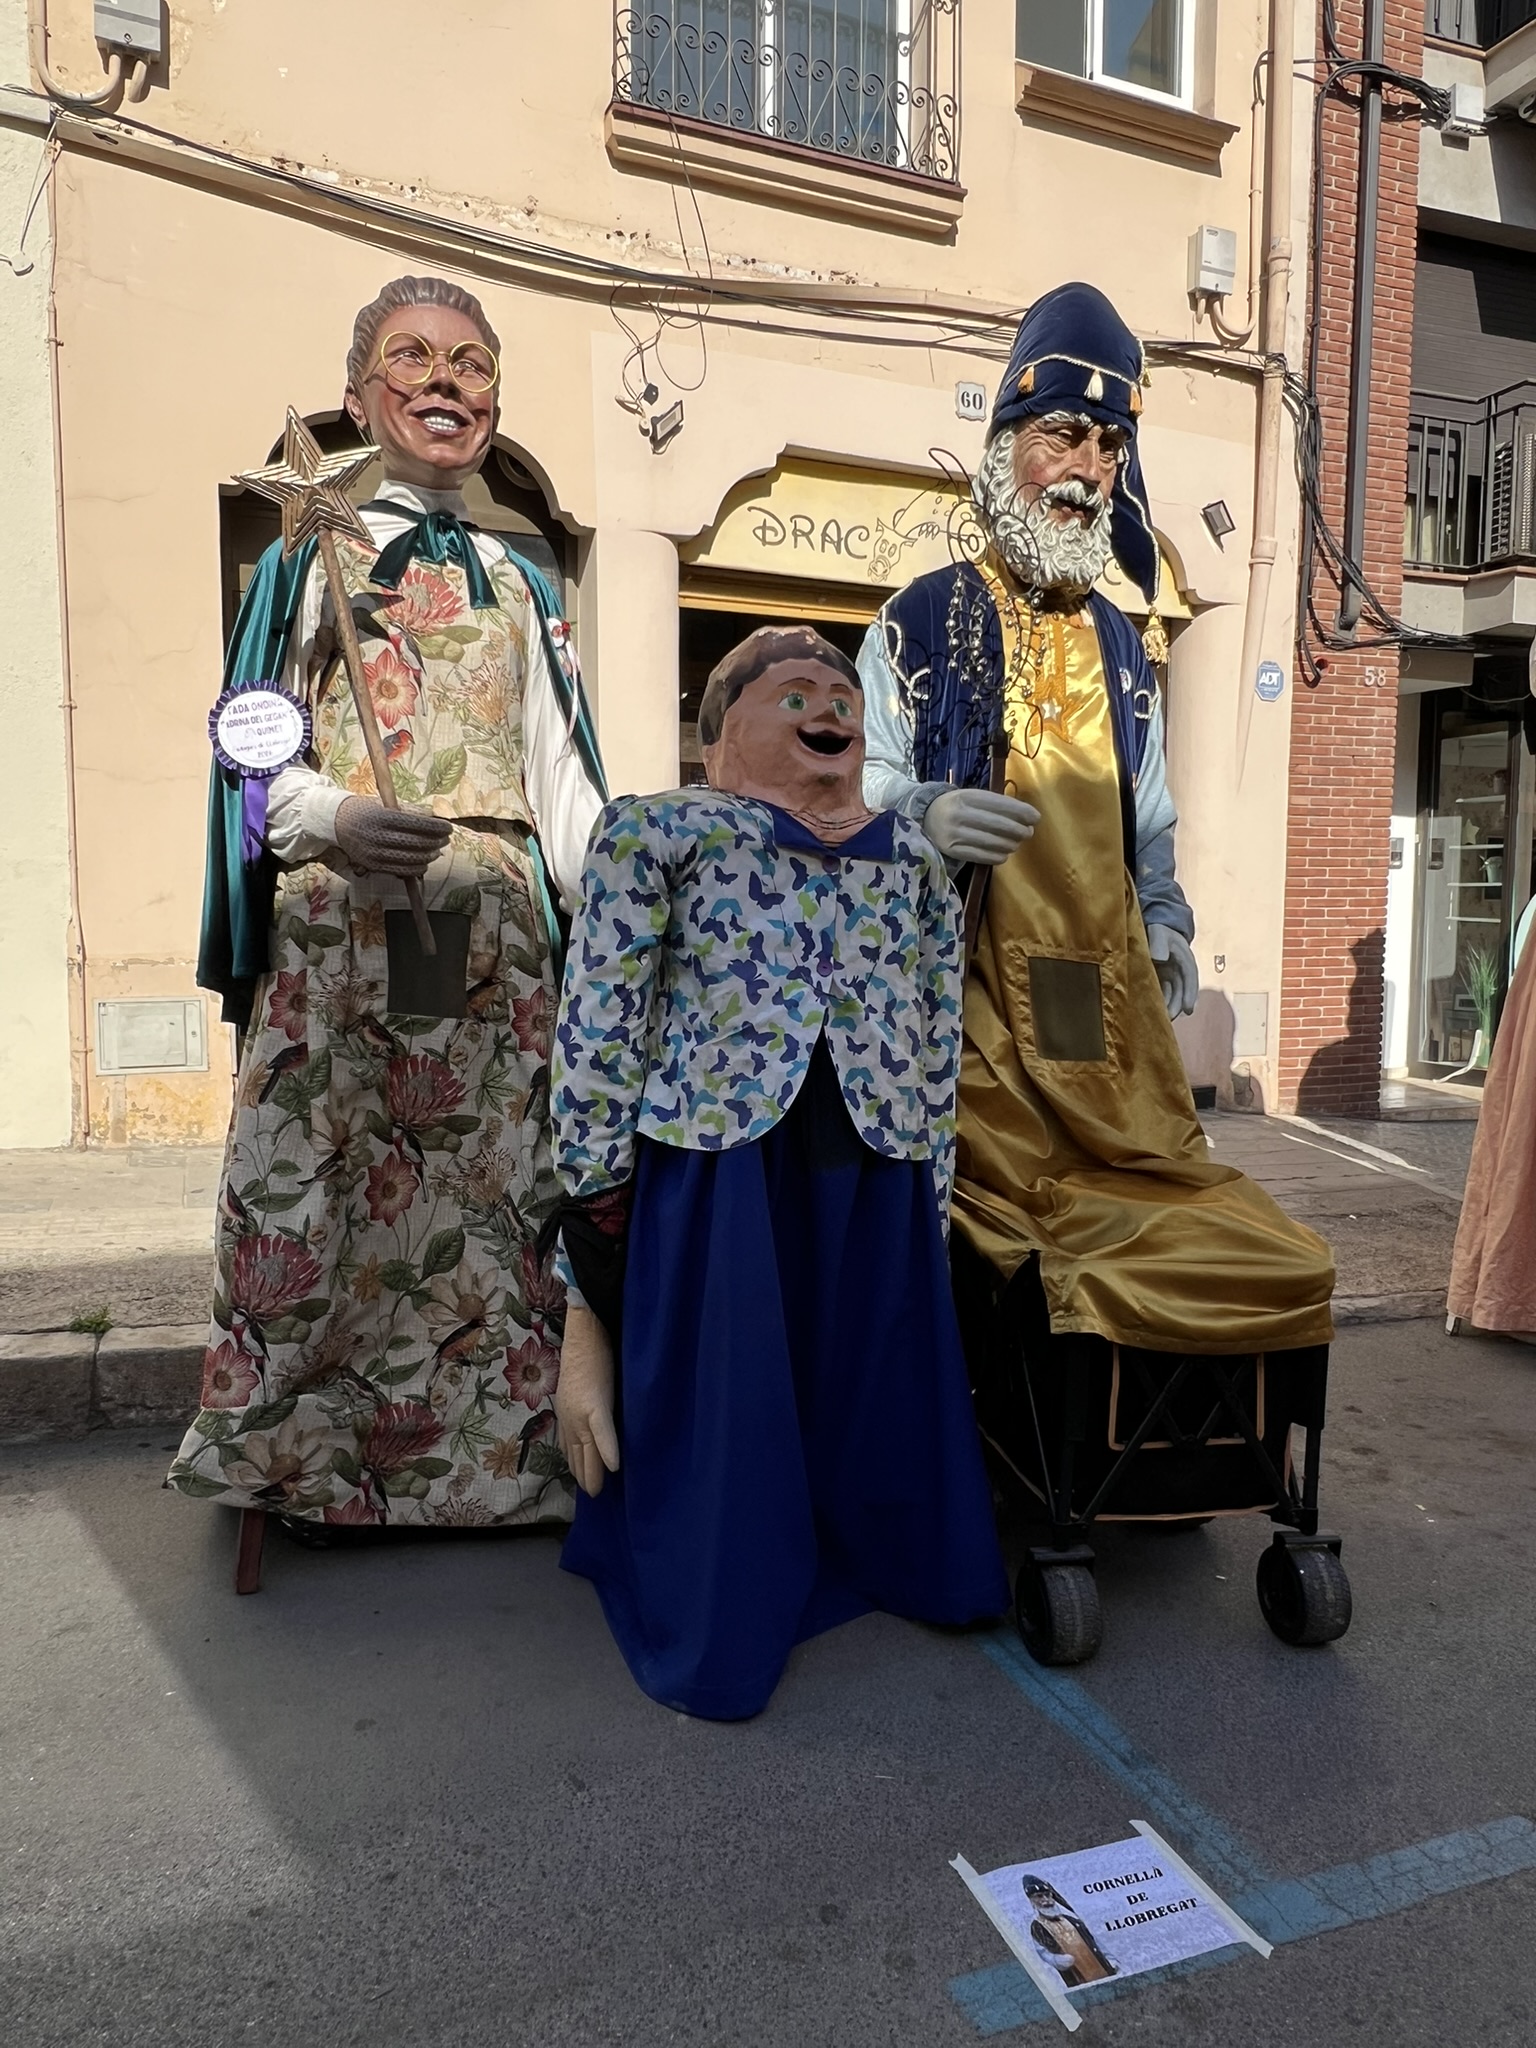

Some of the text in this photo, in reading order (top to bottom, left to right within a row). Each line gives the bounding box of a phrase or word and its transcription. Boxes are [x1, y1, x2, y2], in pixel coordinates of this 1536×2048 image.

[961, 391, 983, 410] 60
[747, 506, 870, 559] DRAC
[1259, 671, 1281, 686] ADT
[1364, 666, 1387, 687] 58
[1126, 1892, 1149, 1905] DE
[1105, 1898, 1197, 1931] LLOBREGAT
